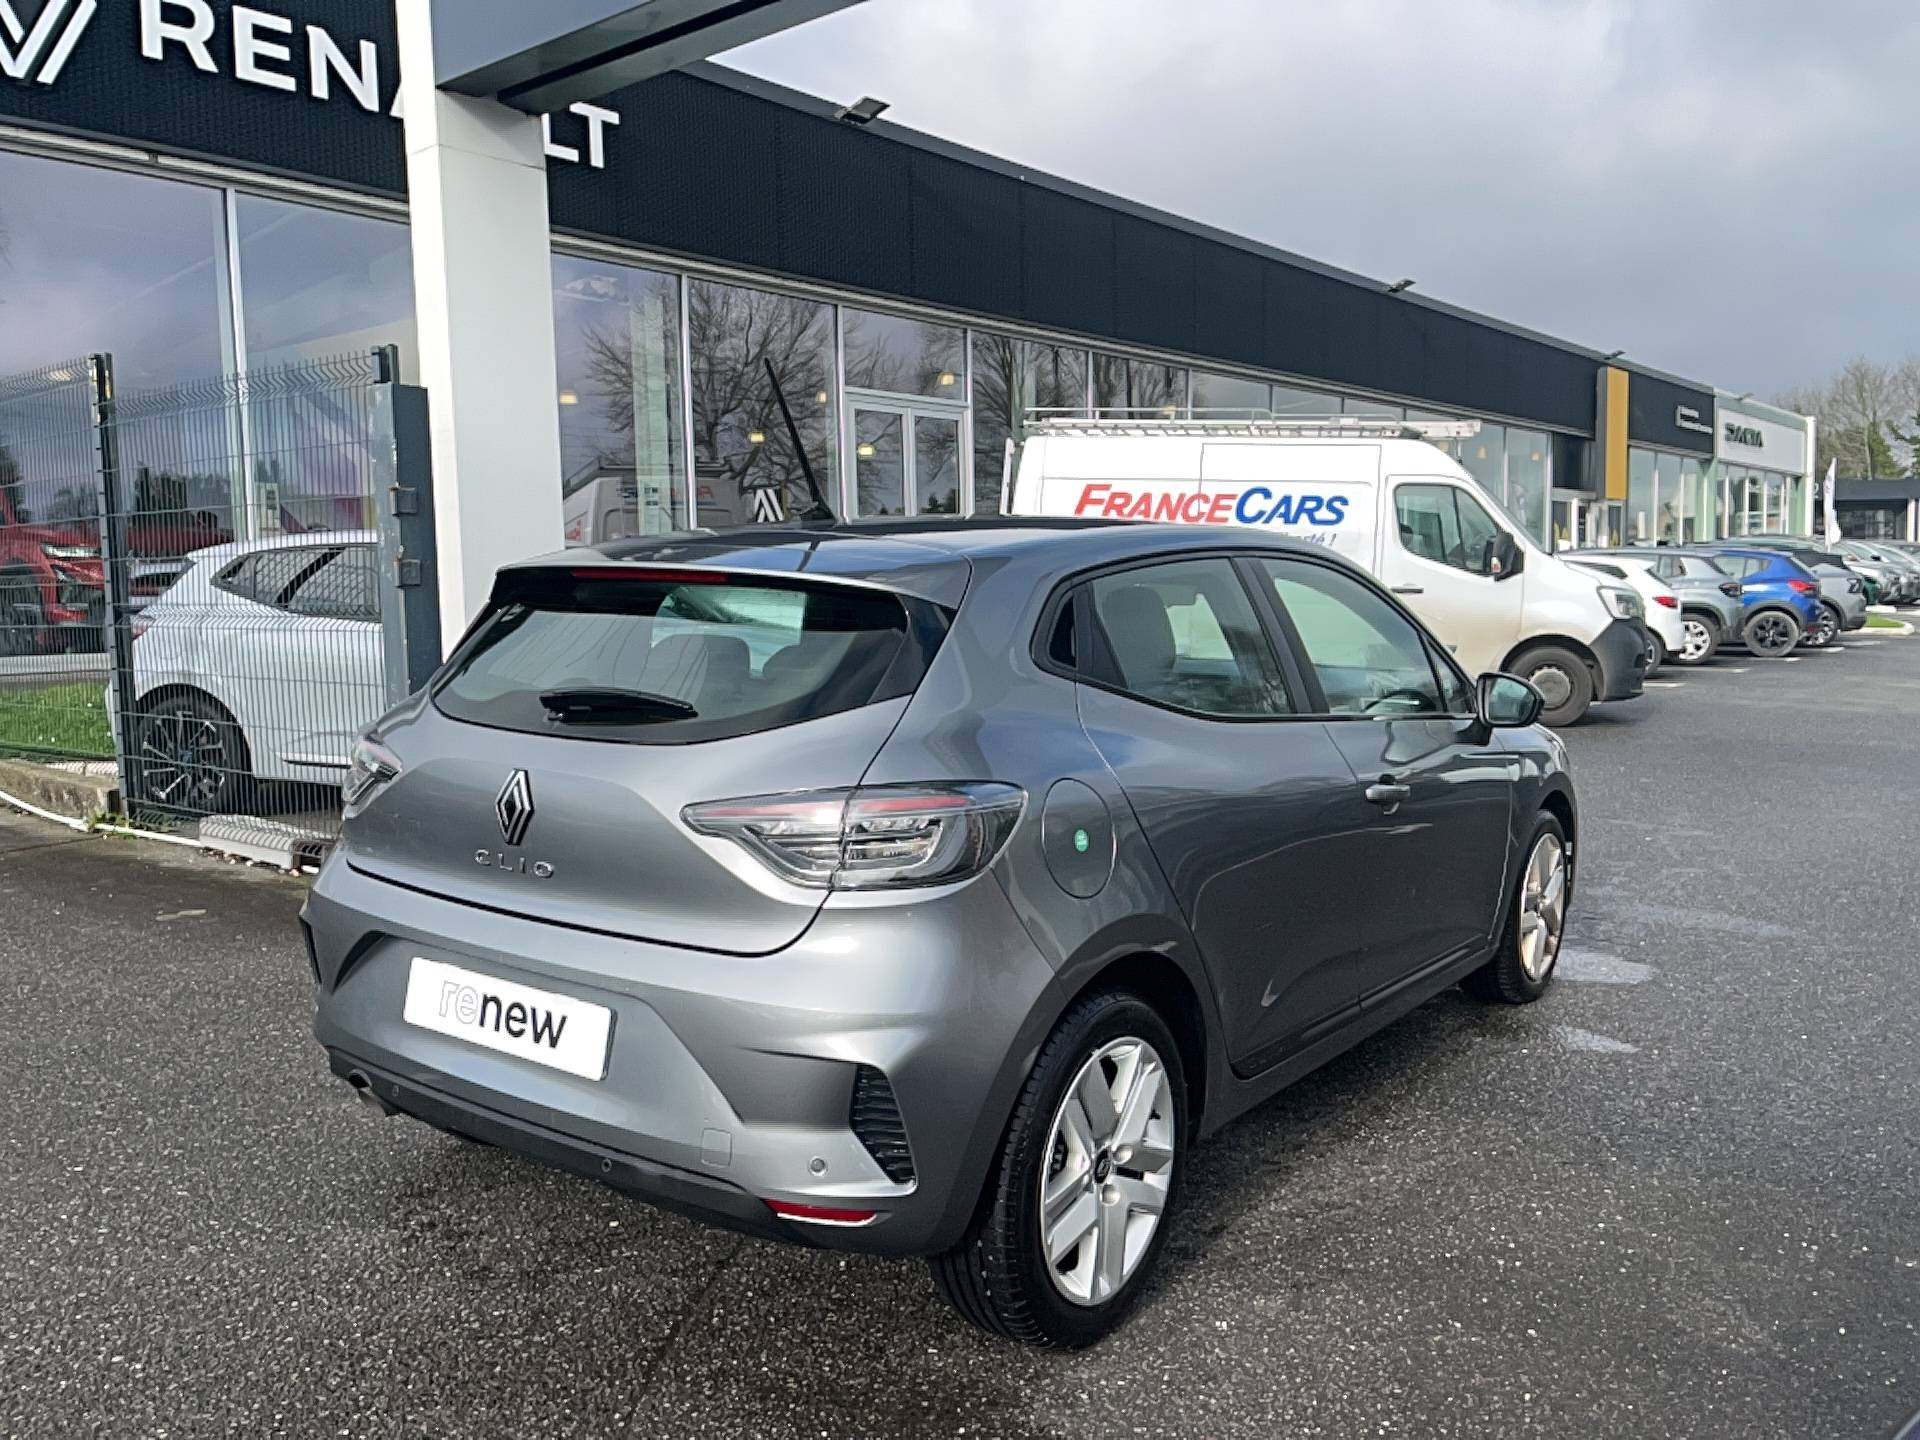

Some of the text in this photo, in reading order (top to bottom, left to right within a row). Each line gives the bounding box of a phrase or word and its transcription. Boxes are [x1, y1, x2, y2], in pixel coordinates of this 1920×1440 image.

[139, 0, 620, 169] RENLT
[474, 849, 555, 879] CLIO
[438, 979, 568, 1049] renew
